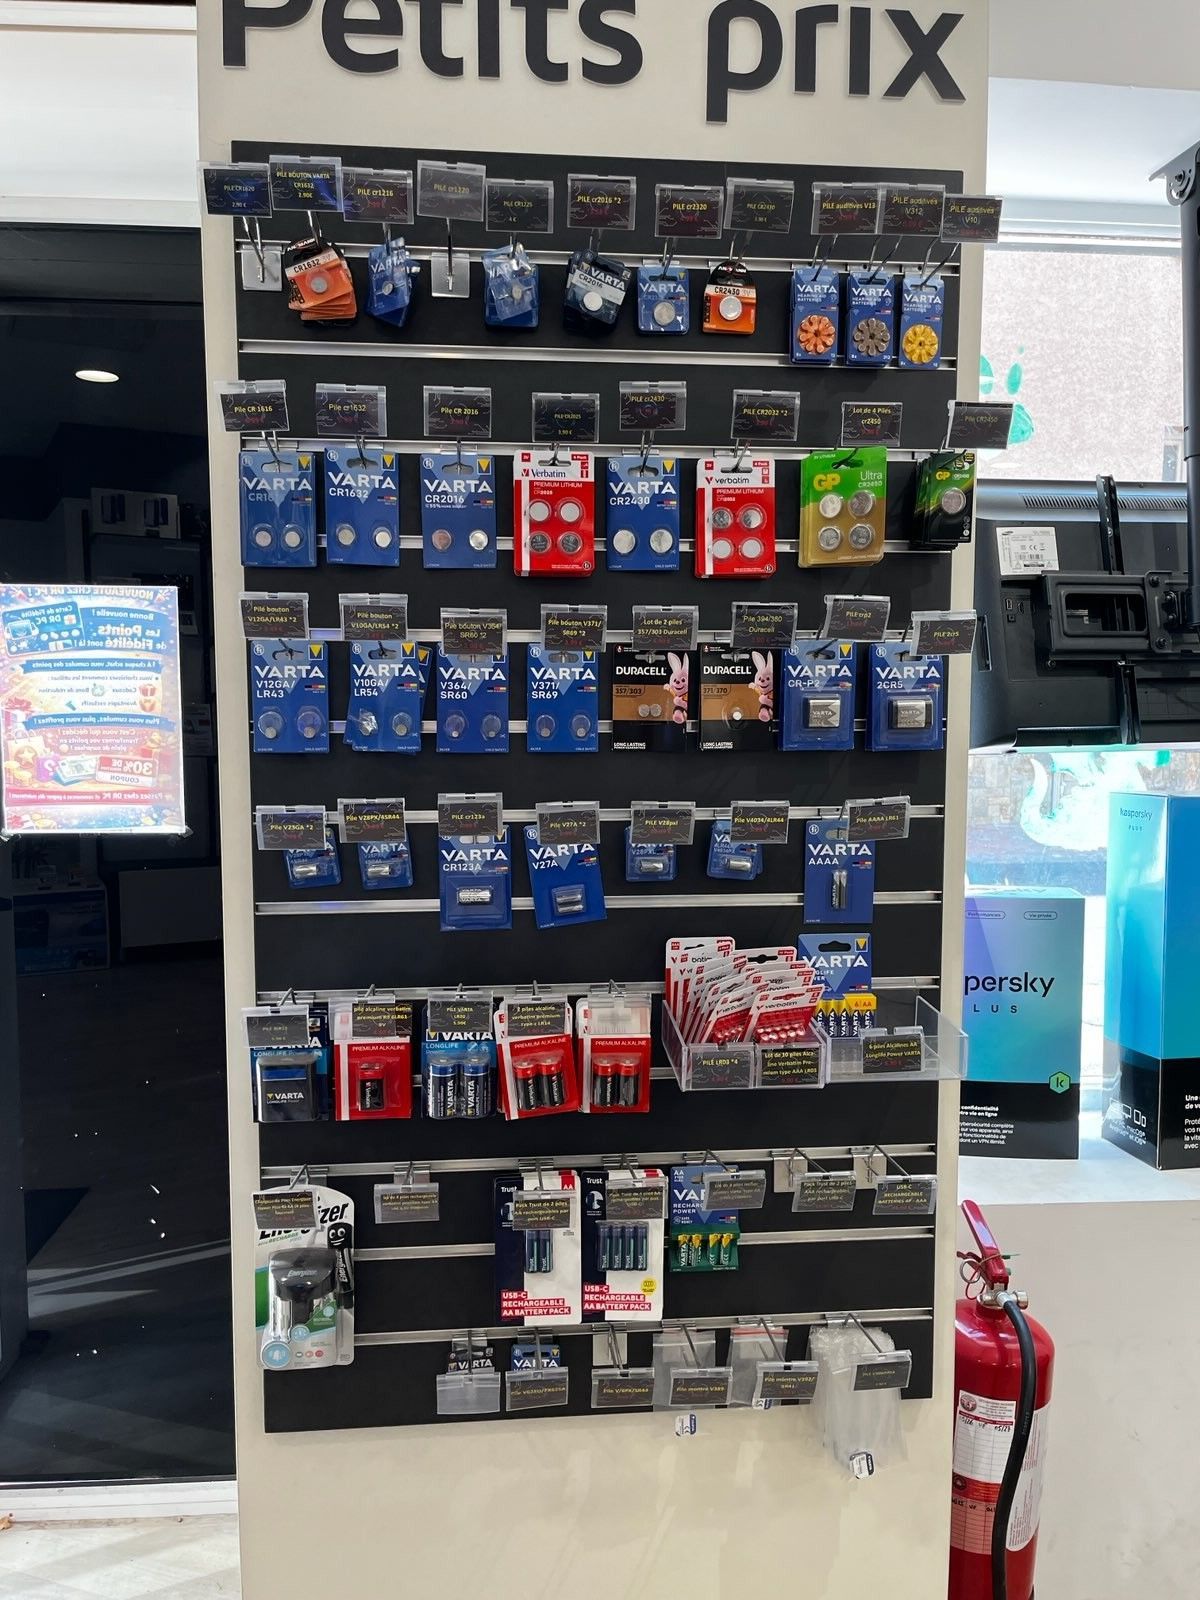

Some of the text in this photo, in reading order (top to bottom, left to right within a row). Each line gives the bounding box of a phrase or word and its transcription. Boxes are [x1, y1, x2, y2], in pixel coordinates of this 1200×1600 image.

[222, 0, 966, 123] Petits prix
[910, 197, 938, 205] auditives
[967, 206, 995, 214] auditives
[293, 259, 321, 273] CR1632
[589, 267, 625, 290] VARTA
[639, 282, 685, 293] VARTA
[714, 286, 740, 296] CR2430
[797, 284, 837, 293] VARTA
[852, 288, 892, 297] VARTA
[904, 294, 942, 304] VARTA
[531, 469, 566, 478] Verbatim
[860, 471, 882, 480] Ultra
[936, 472, 950, 480] GP
[243, 477, 312, 491] VARTA
[328, 472, 396, 489] VARTA
[813, 473, 840, 491] GP
[424, 479, 492, 493] VARTA
[610, 481, 676, 494] VARTA
[329, 488, 369, 498] CR1632
[425, 495, 464, 504] CR2016
[610, 497, 650, 505] CR2430
[254, 665, 324, 678] VARTA
[352, 664, 416, 676] VARTA
[439, 667, 506, 681] VARTA
[531, 667, 596, 680] VARTA
[616, 667, 666, 676] DURACELL
[703, 666, 751, 675] DURACELL
[788, 665, 852, 677] VARTA
[876, 666, 940, 679] VARTA
[256, 680, 295, 689] V12GA/
[354, 679, 389, 687] V10GA/
[440, 681, 471, 690] V364/
[531, 681, 560, 690] V371/
[788, 680, 820, 688] CR-P2
[877, 681, 902, 689] 2CR5
[257, 690, 284, 698] LR43
[354, 688, 378, 697] LR54
[440, 691, 468, 699] SR60
[531, 690, 558, 699] SR69
[1120, 808, 1152, 820] kaspersky
[361, 842, 408, 852] VARTA
[529, 844, 595, 860] VARTA
[808, 844, 872, 856] VARTA
[441, 849, 508, 861] VARTA
[533, 860, 558, 869] V27A
[803, 955, 868, 967] VARTA
[965, 972, 1055, 998] persky
